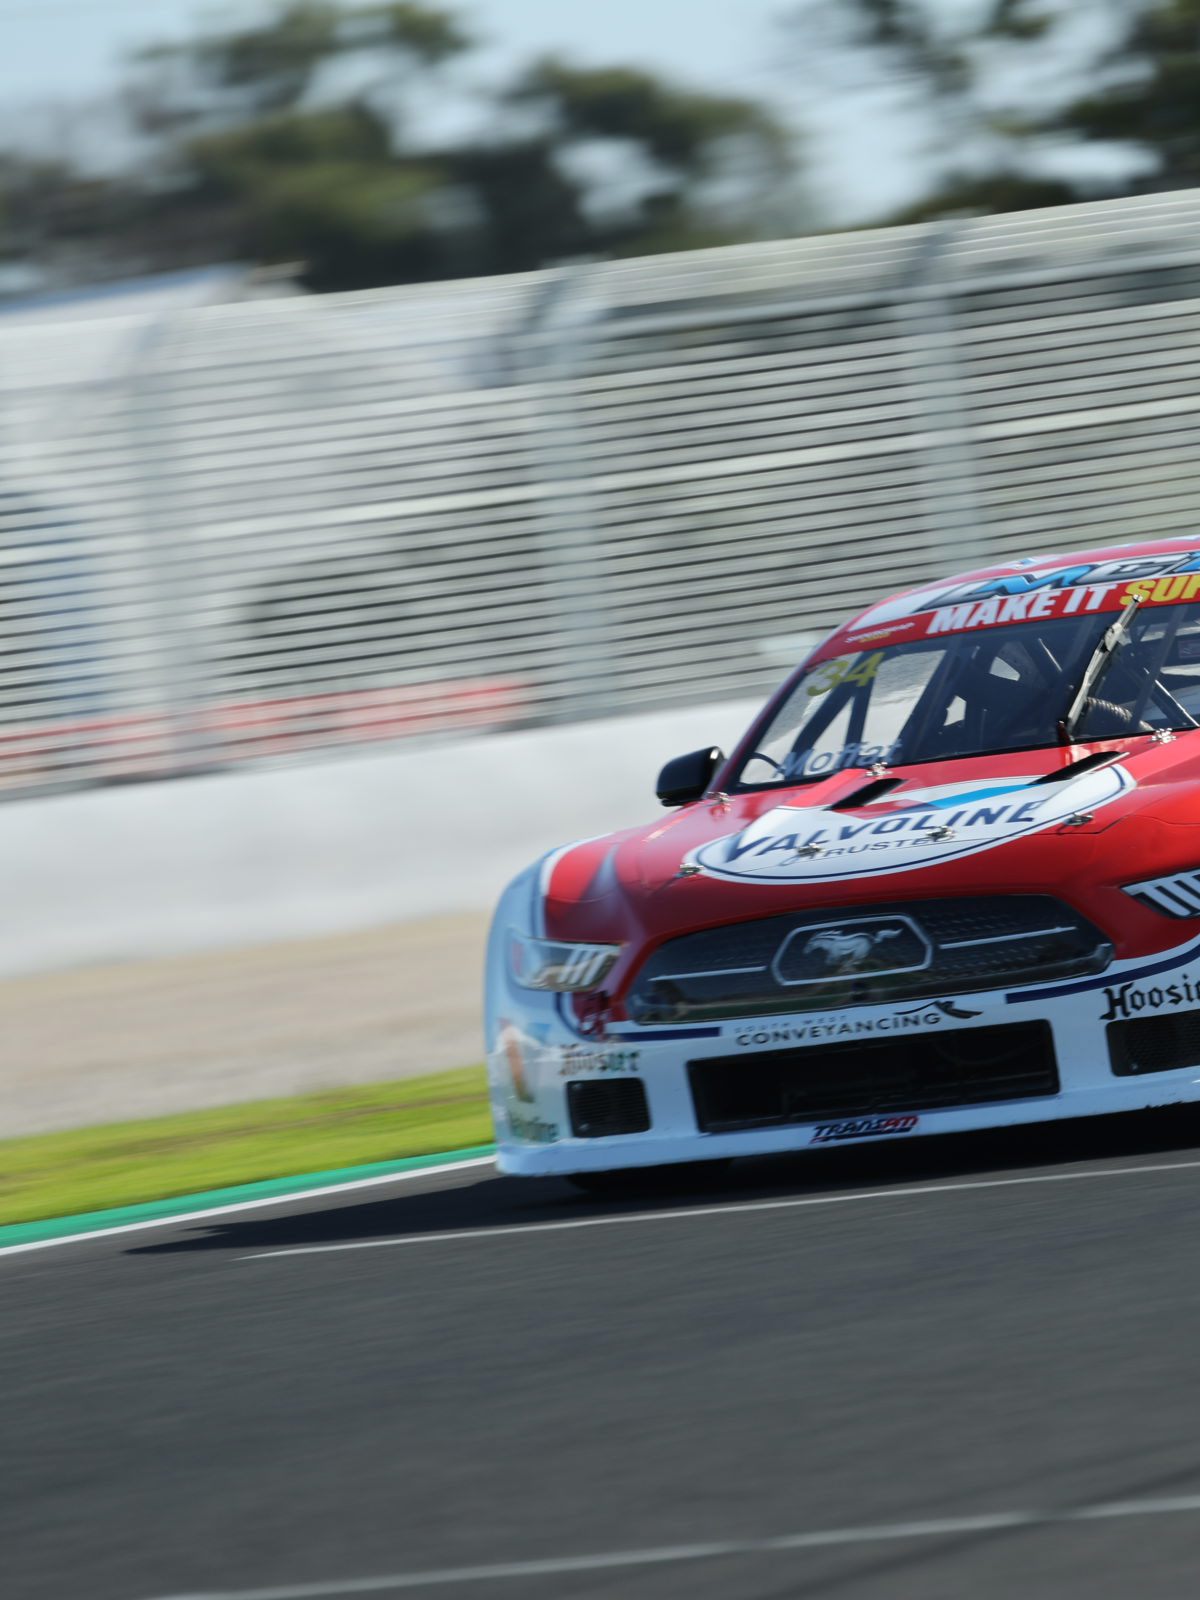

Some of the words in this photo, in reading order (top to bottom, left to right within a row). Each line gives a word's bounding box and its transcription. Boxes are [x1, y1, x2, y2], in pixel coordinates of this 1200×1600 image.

[926, 589, 1056, 635] MAKE
[1065, 583, 1118, 614] IT
[806, 651, 886, 697] 34
[725, 798, 1046, 863] VALVOLINE
[735, 1012, 942, 1047] CONVEYANCING
